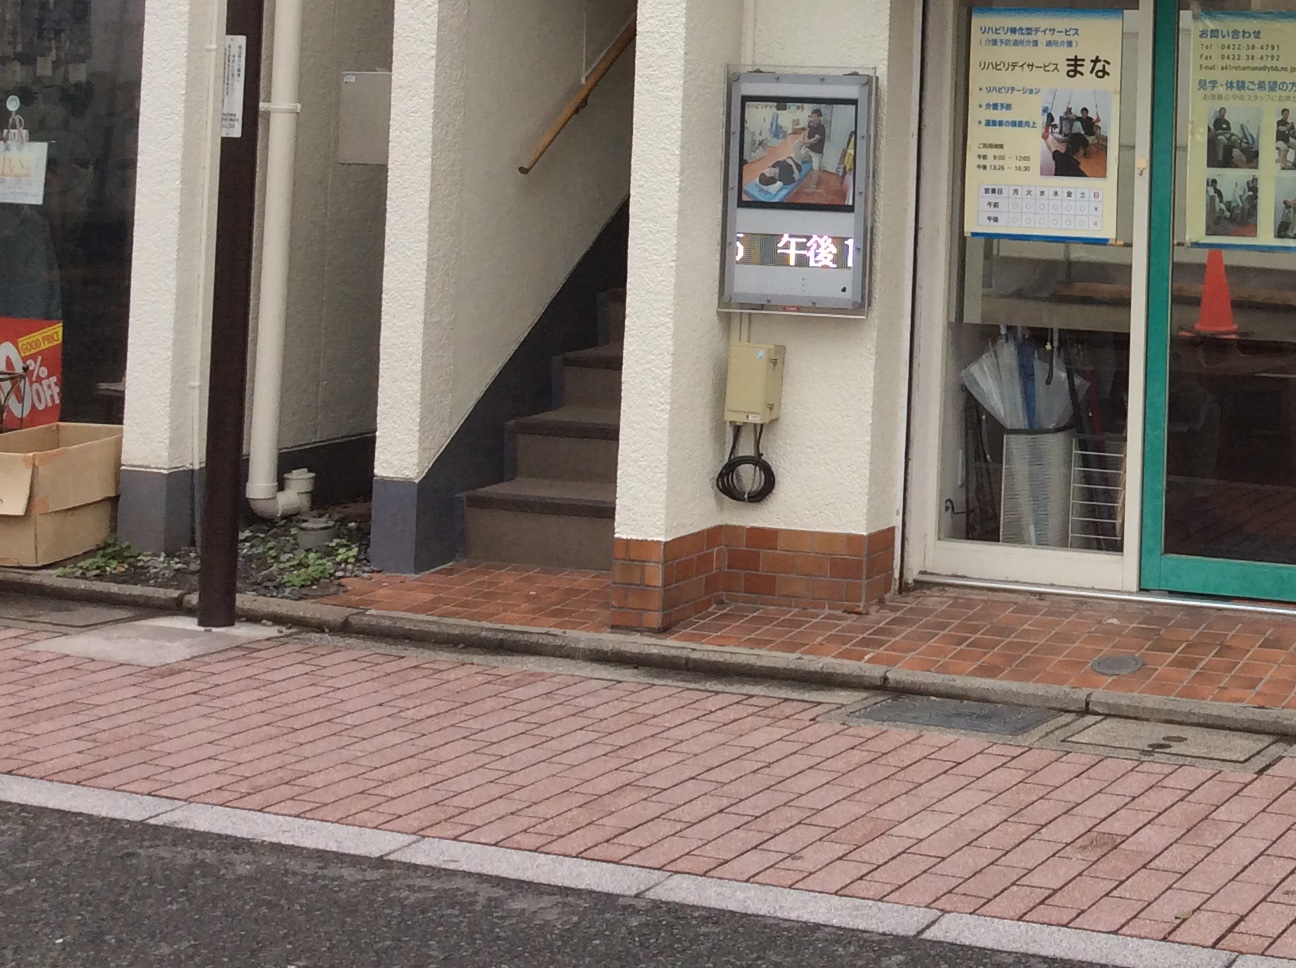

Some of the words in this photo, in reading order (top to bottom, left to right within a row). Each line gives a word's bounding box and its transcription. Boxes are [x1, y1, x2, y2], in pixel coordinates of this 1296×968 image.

[978, 60, 1060, 73] リハビリデイサービス
[1065, 54, 1112, 80] まな
[31, 376, 60, 411] OFF
